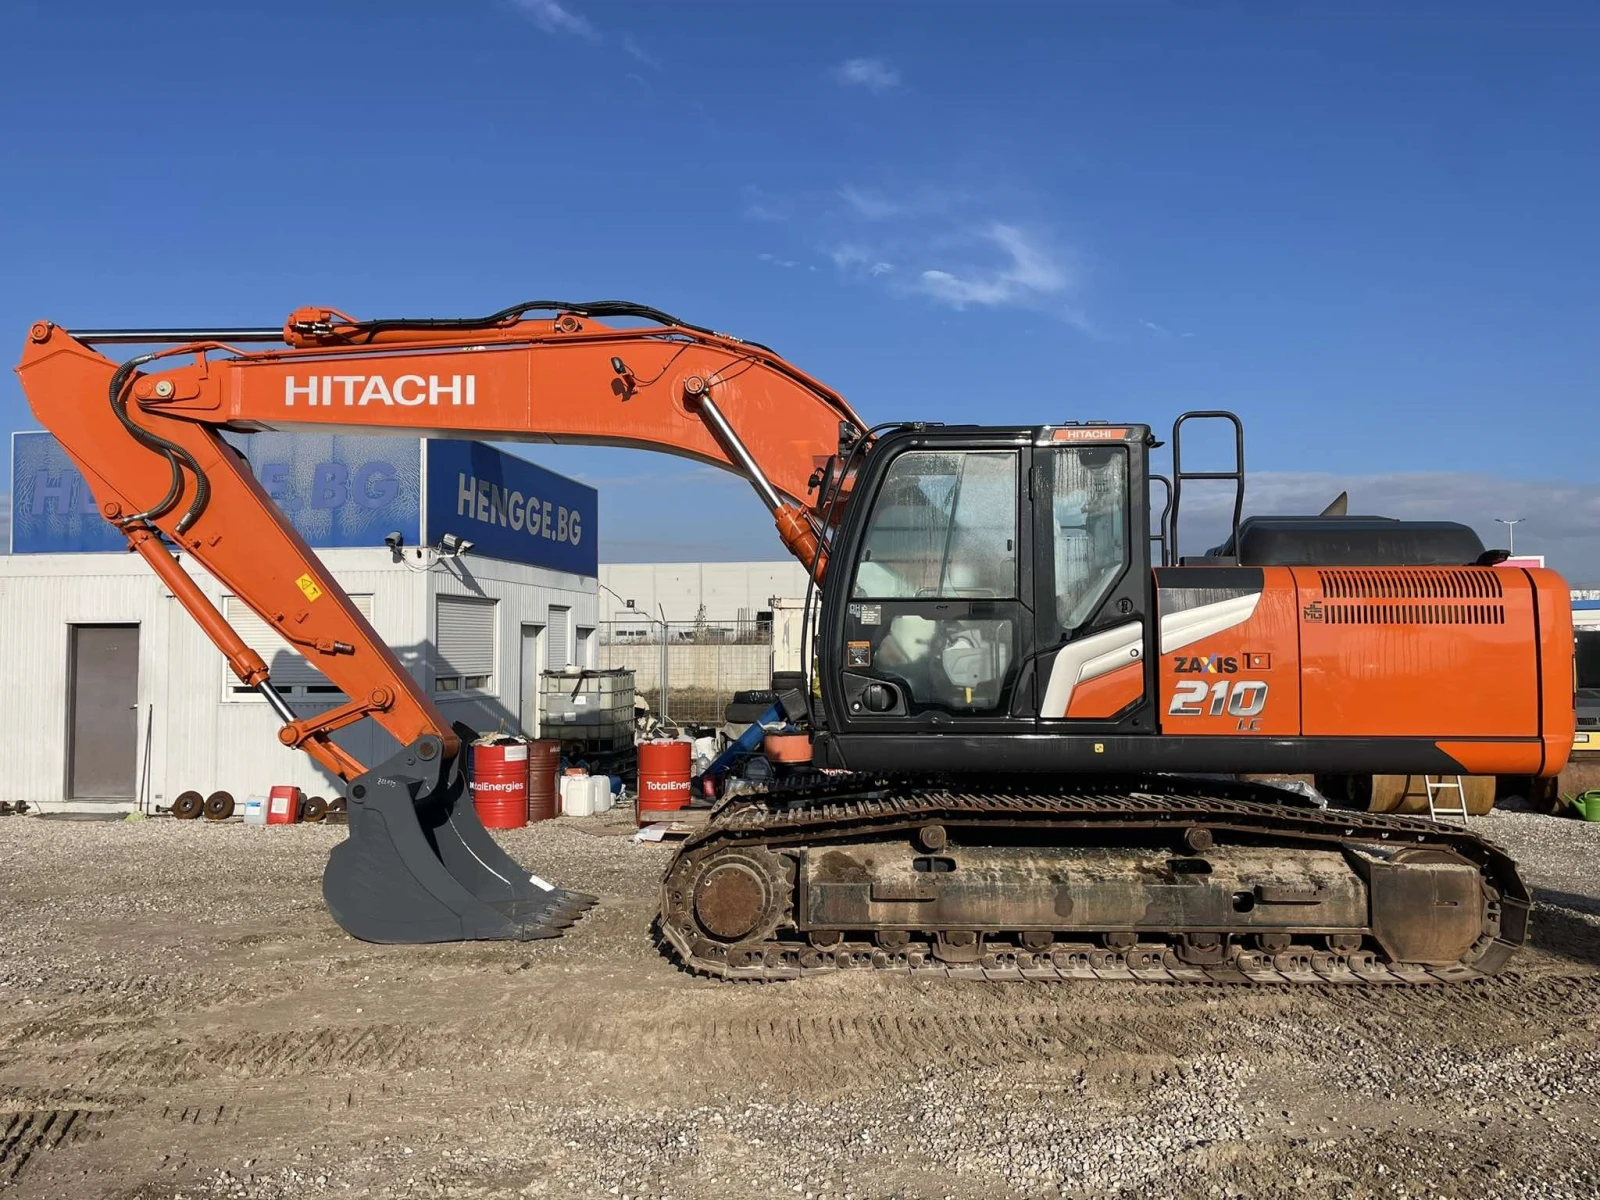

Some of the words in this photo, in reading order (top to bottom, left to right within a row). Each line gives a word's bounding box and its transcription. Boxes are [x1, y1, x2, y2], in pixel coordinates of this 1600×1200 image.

[285, 374, 476, 406] HITACHI
[1067, 431, 1112, 439] HITACHI
[457, 472, 582, 546] HENGGE.BG
[1174, 652, 1239, 674] ZAXIS
[1168, 680, 1269, 716] 210
[1236, 717, 1263, 731] LC
[473, 782, 524, 793] talEnergies
[646, 781, 691, 790] TotalEnerg
